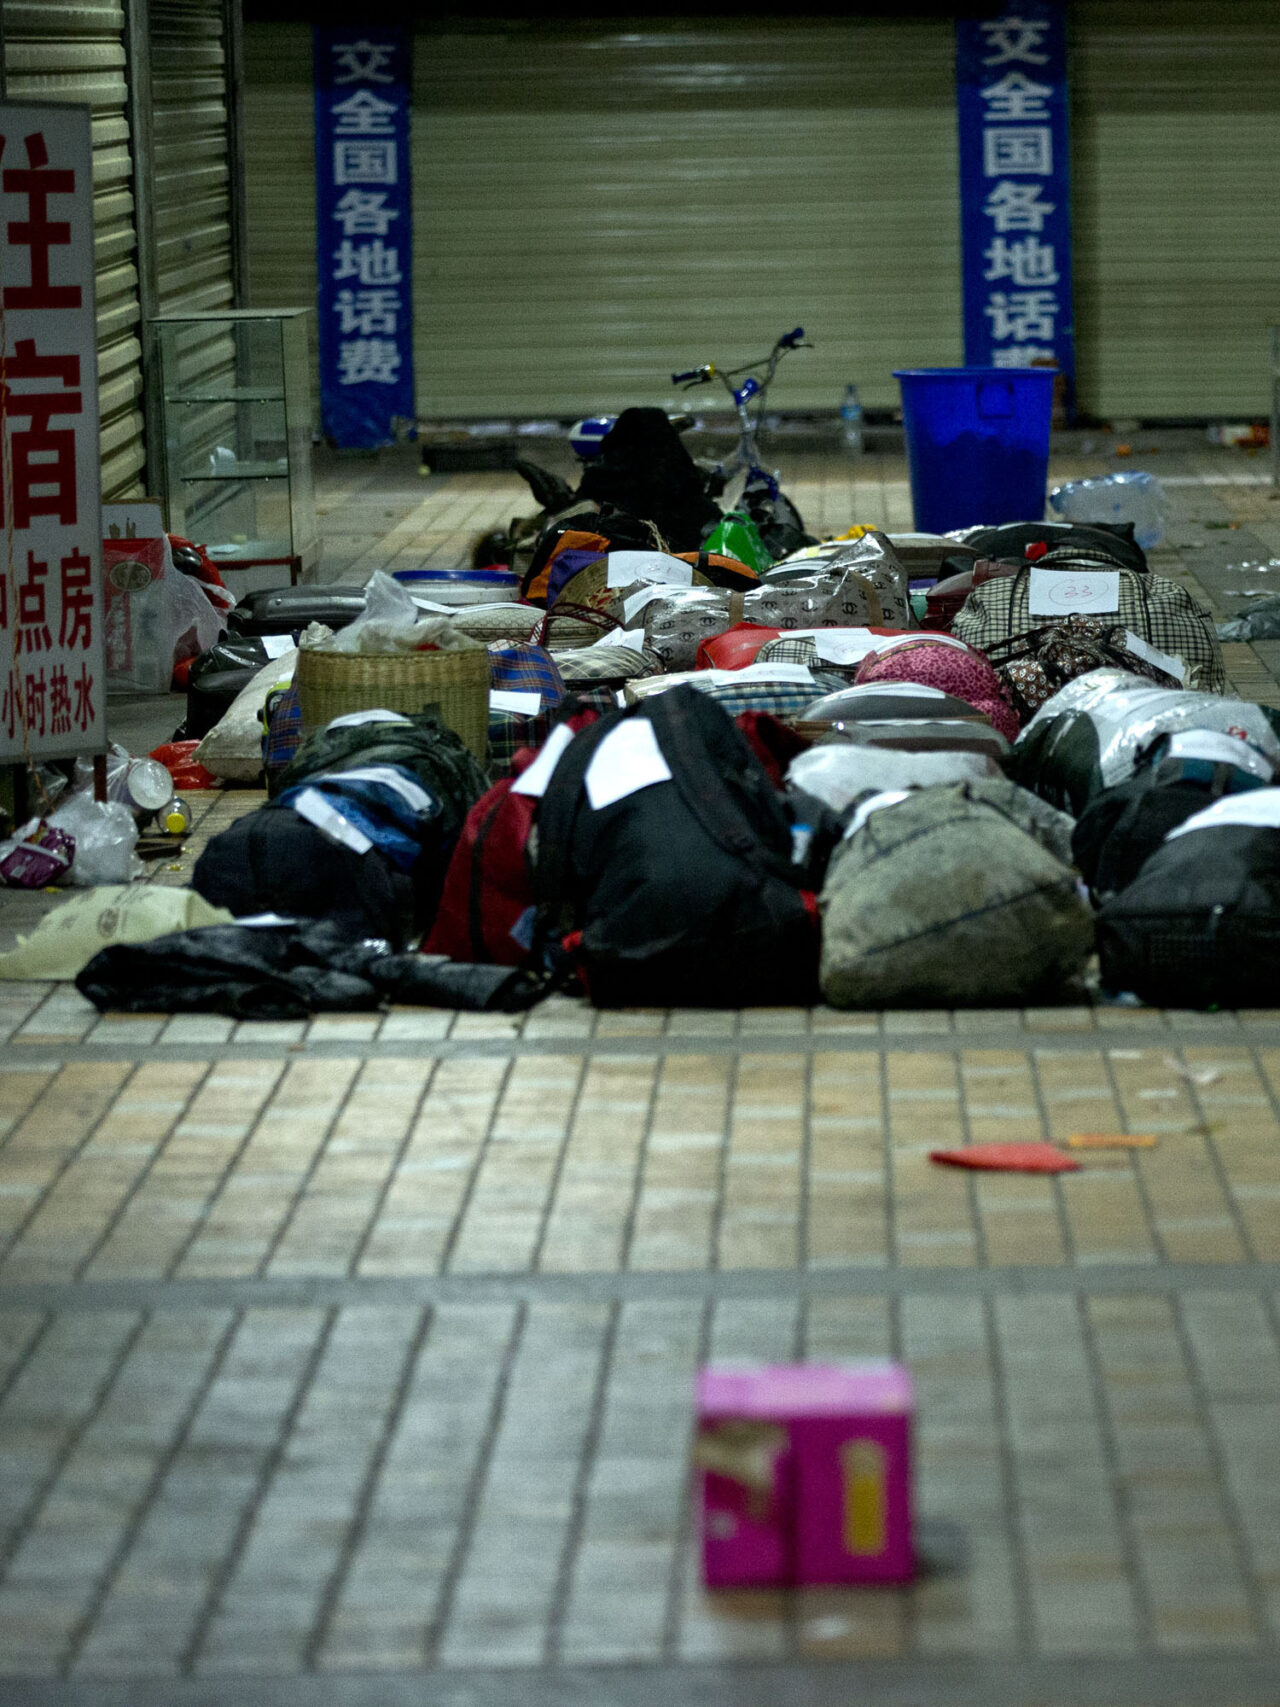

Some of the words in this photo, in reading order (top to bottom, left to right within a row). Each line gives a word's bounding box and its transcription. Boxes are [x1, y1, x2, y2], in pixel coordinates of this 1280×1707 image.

[331, 39, 402, 385] 交全国各地话费
